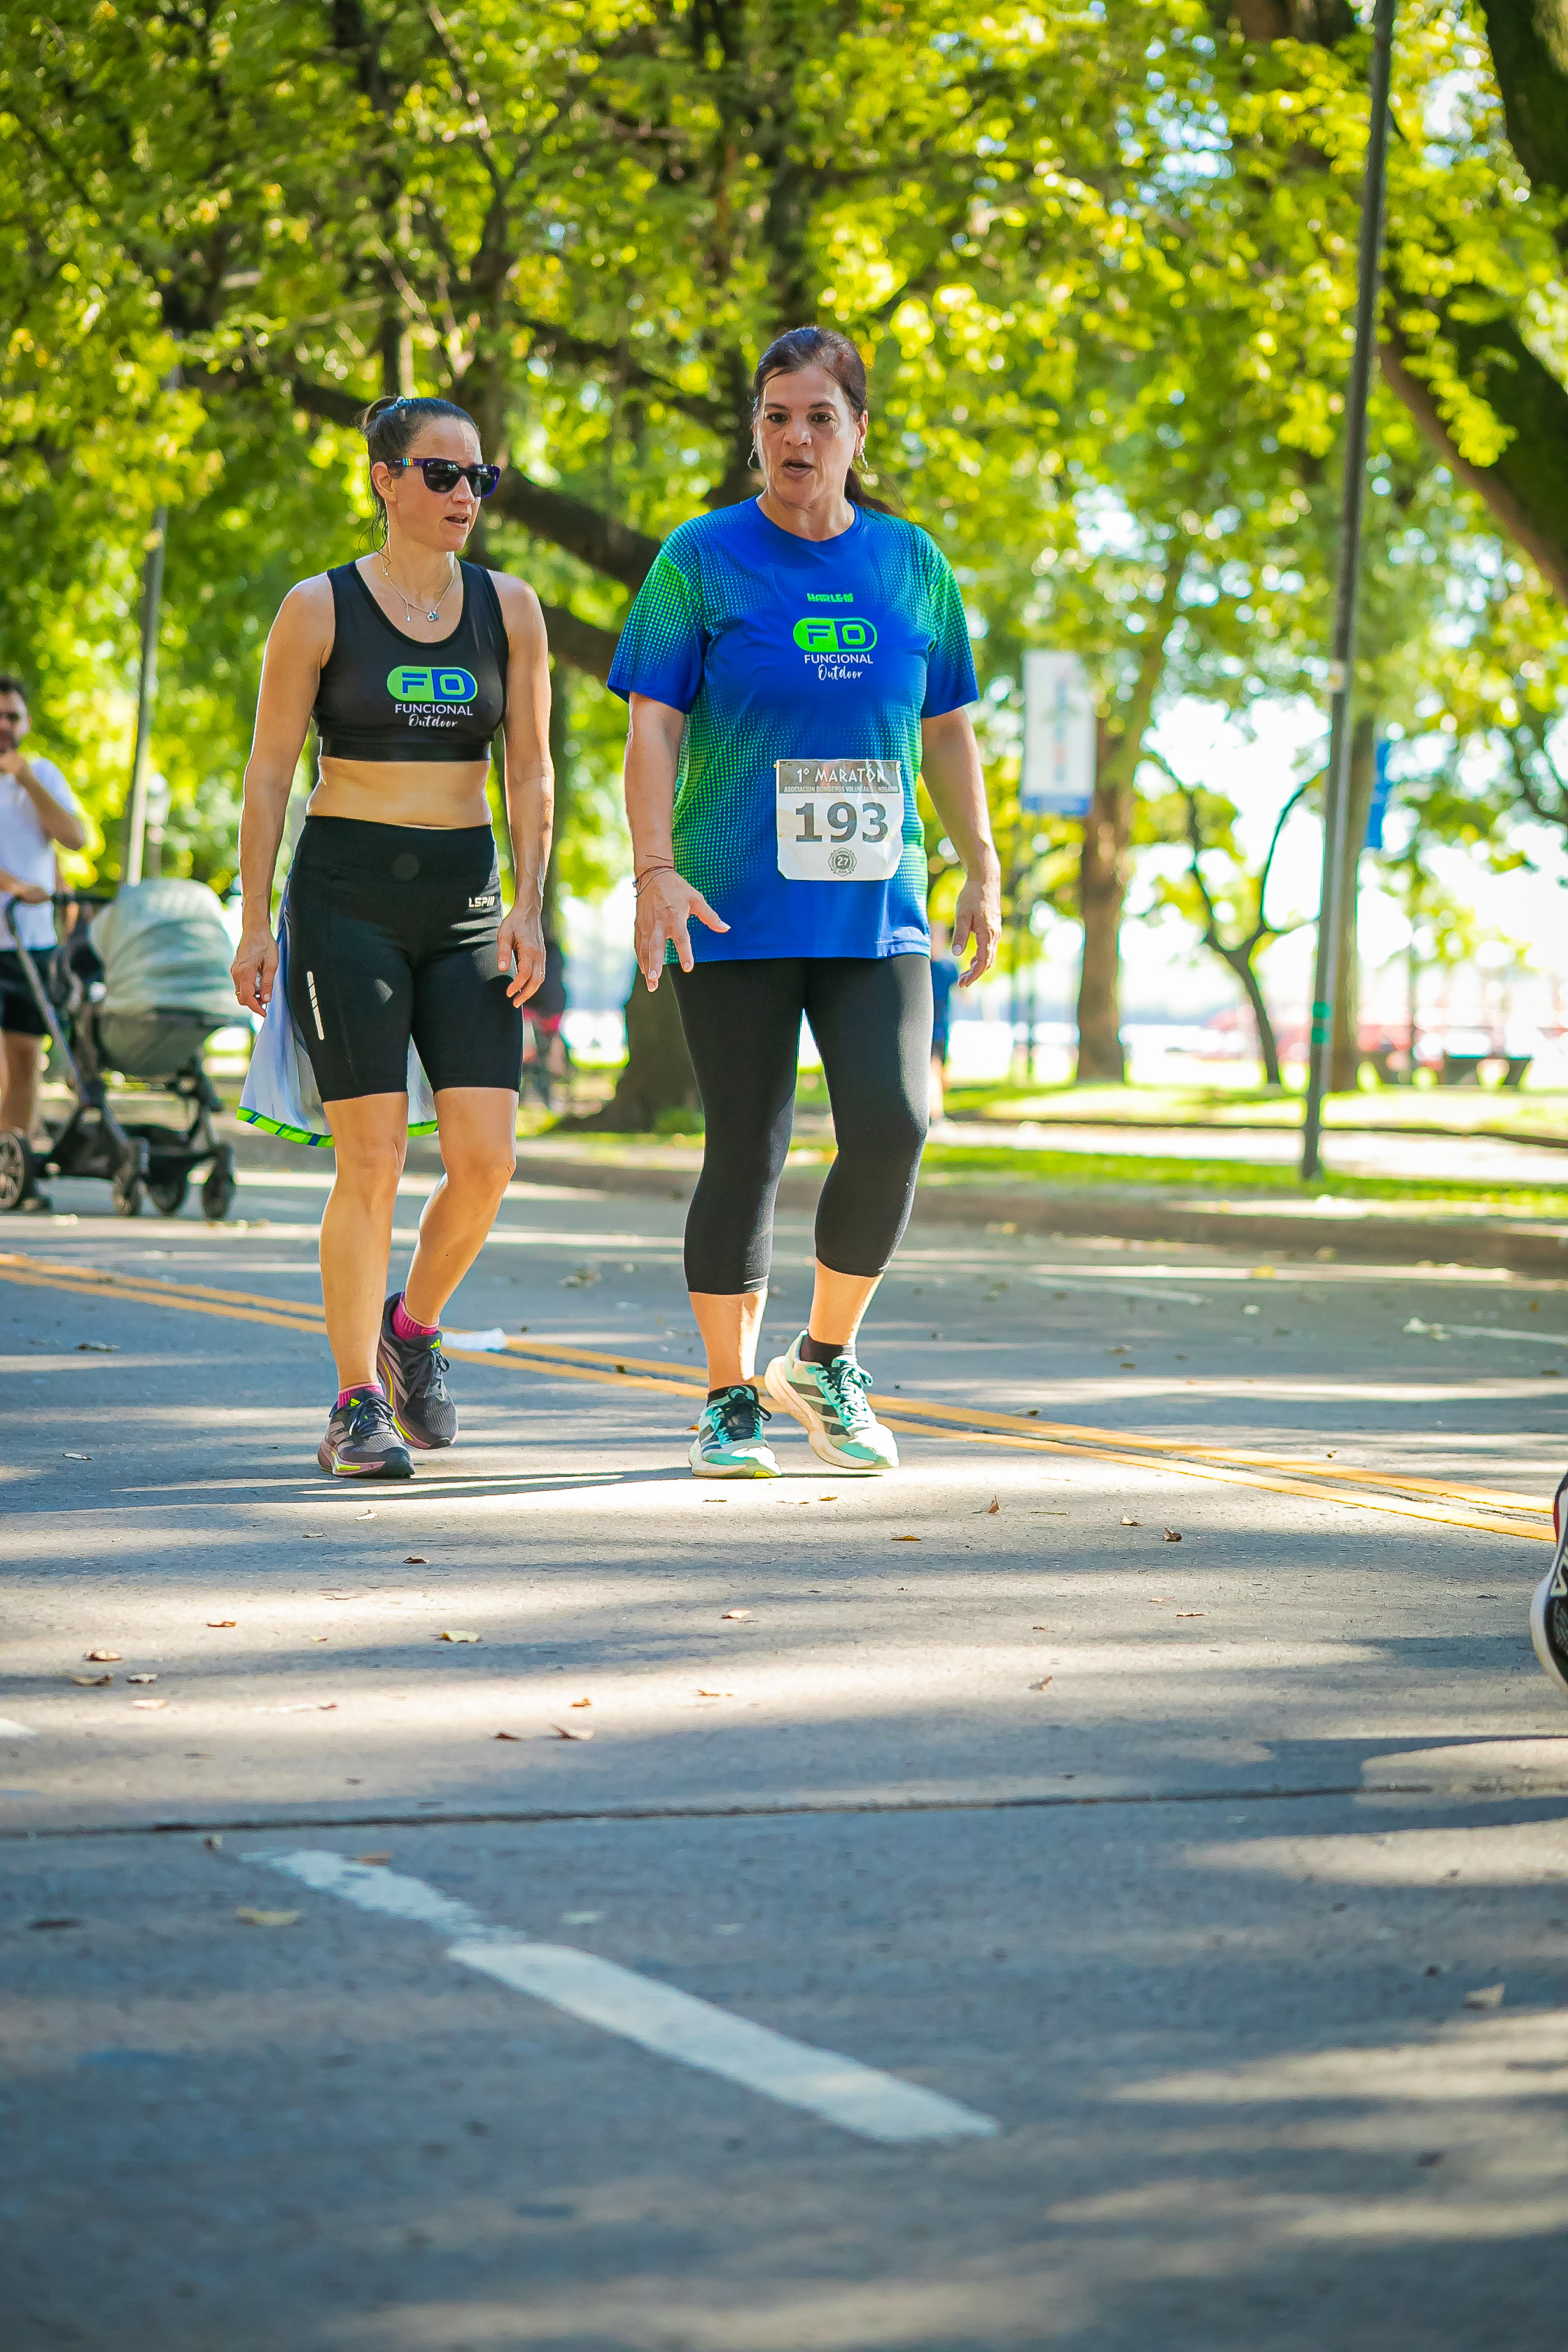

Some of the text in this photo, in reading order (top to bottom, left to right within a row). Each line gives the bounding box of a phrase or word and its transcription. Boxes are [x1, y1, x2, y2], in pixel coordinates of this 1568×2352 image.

[804, 654, 874, 664] FUNCIONAL
[818, 664, 863, 681] Outdoor
[395, 704, 474, 716] FUNCIONAL
[408, 713, 458, 727] Outdoor
[795, 802, 888, 843] 193
[837, 856, 849, 867] 27
